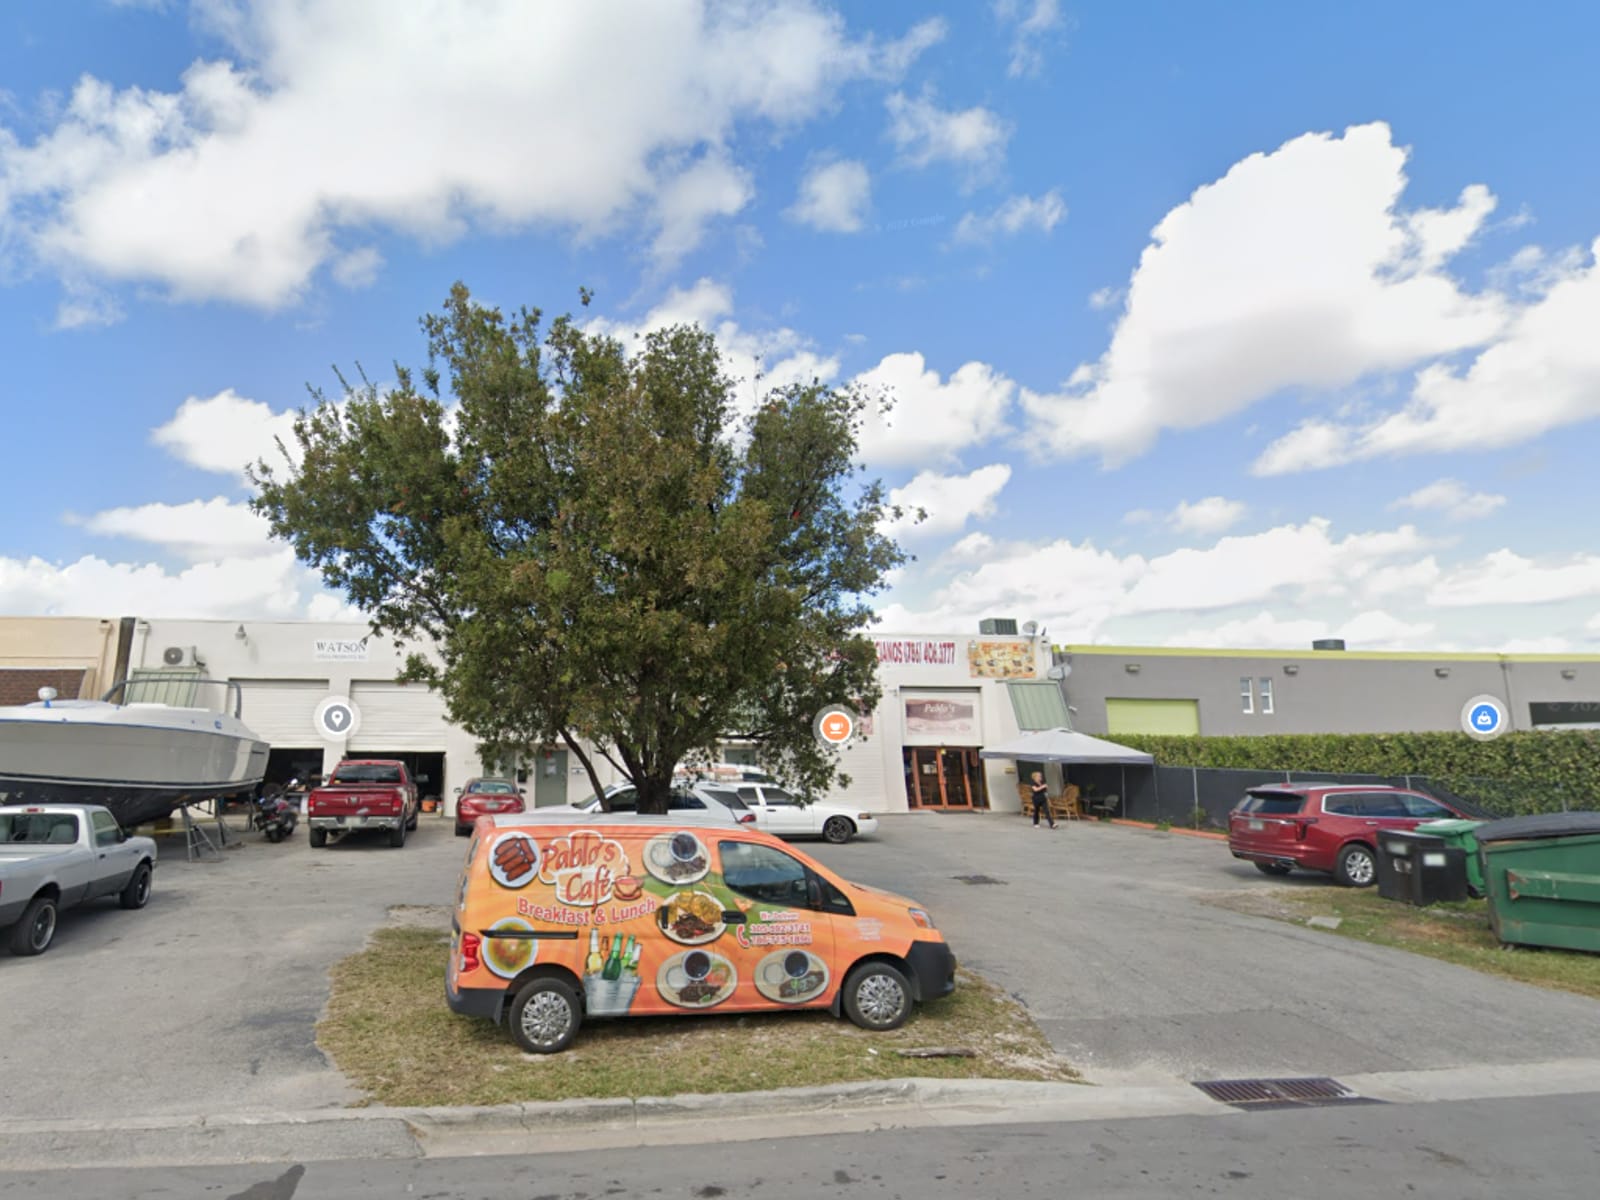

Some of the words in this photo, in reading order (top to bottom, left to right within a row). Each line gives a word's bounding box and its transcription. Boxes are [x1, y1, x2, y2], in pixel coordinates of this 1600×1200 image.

[316, 641, 367, 653] WATSON
[541, 833, 616, 873] Pablo's
[565, 864, 611, 913] Café
[518, 896, 590, 925] Breakfast
[594, 908, 607, 925] &
[611, 898, 657, 922] Lunch
